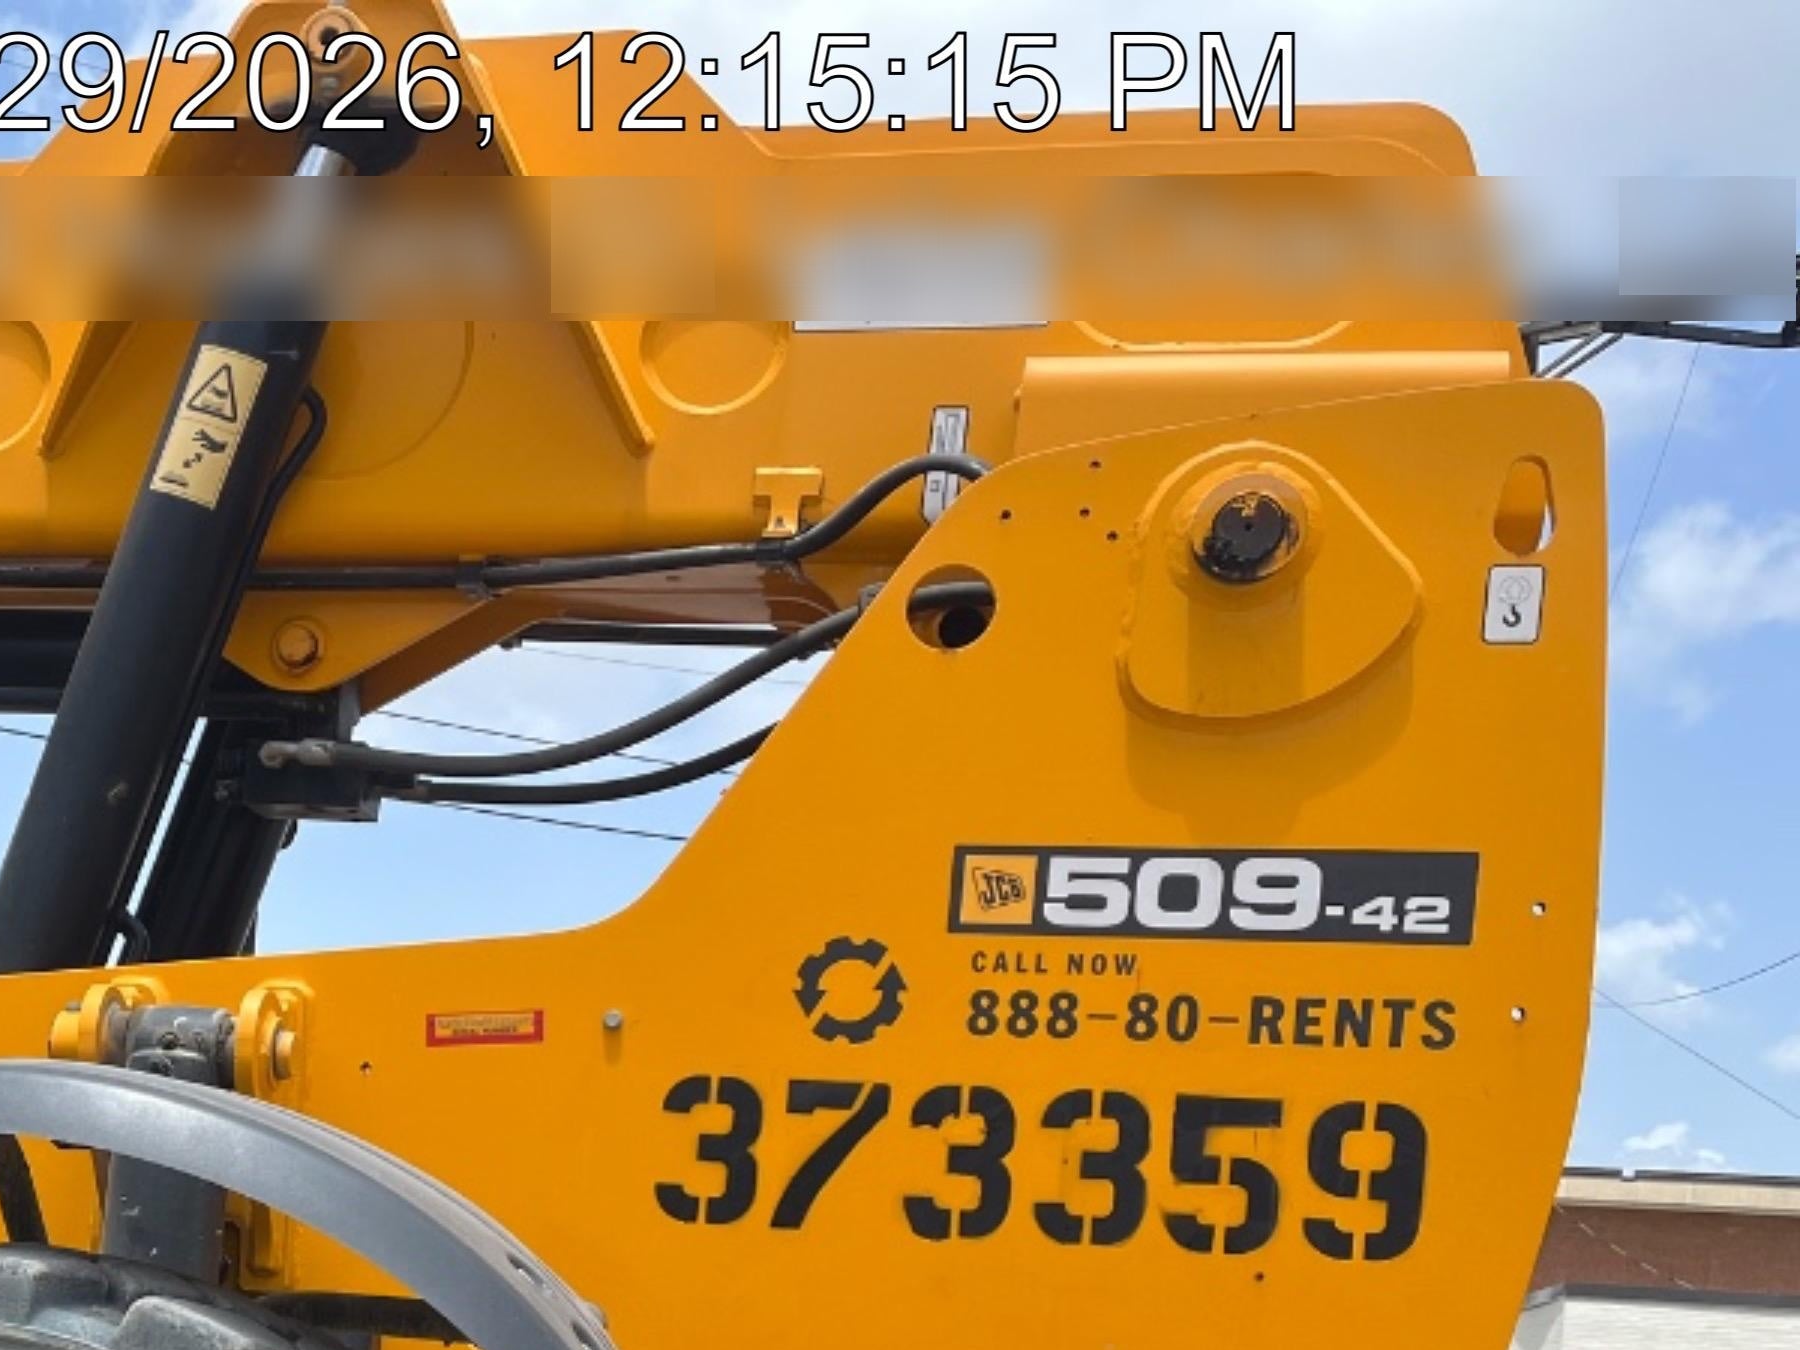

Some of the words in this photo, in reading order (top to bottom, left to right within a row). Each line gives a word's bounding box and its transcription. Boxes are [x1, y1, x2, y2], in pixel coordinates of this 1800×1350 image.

[1043, 855, 1452, 936] 509-42
[971, 950, 1049, 974] CALL
[1067, 953, 1139, 977] NOW
[966, 989, 1457, 1051] 888-80-RENTS
[653, 1075, 1428, 1262] 373359
